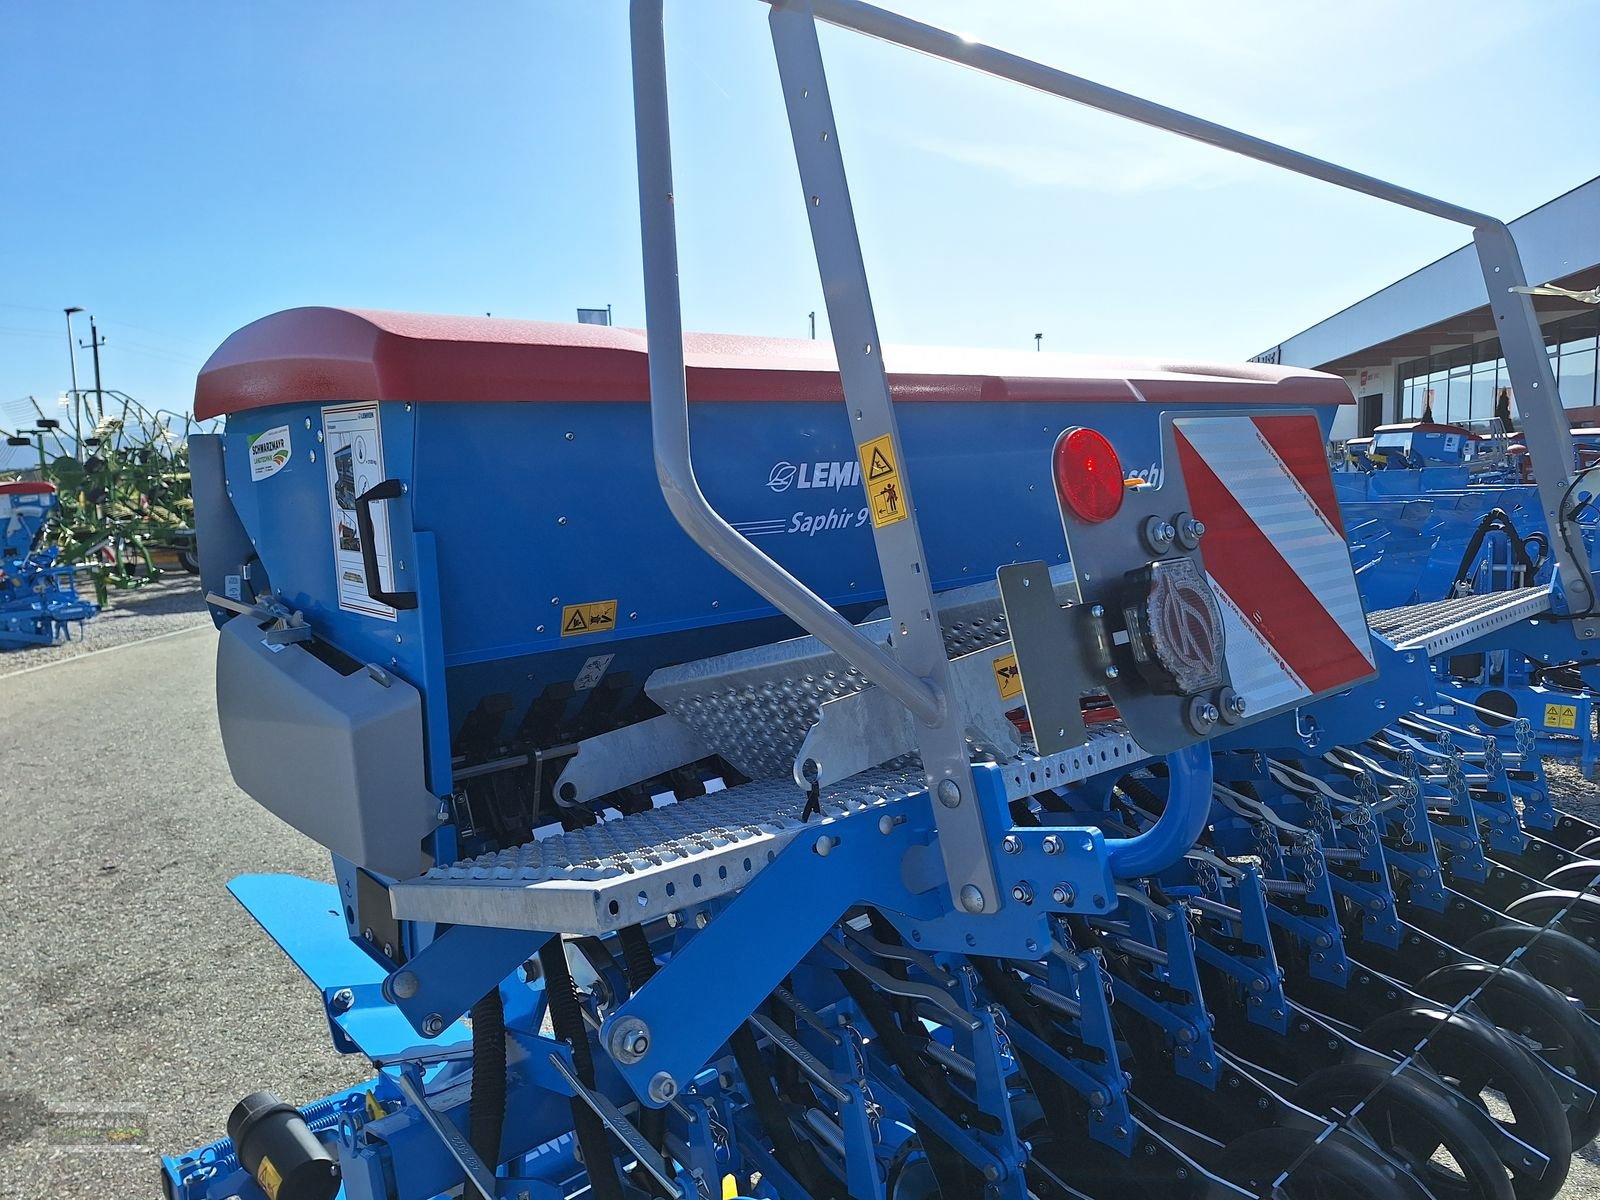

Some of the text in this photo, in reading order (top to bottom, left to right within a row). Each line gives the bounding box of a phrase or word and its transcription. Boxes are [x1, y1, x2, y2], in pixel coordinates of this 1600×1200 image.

[252, 438, 285, 455] SCHWARZMAYR
[787, 507, 871, 537] Saphir 9
